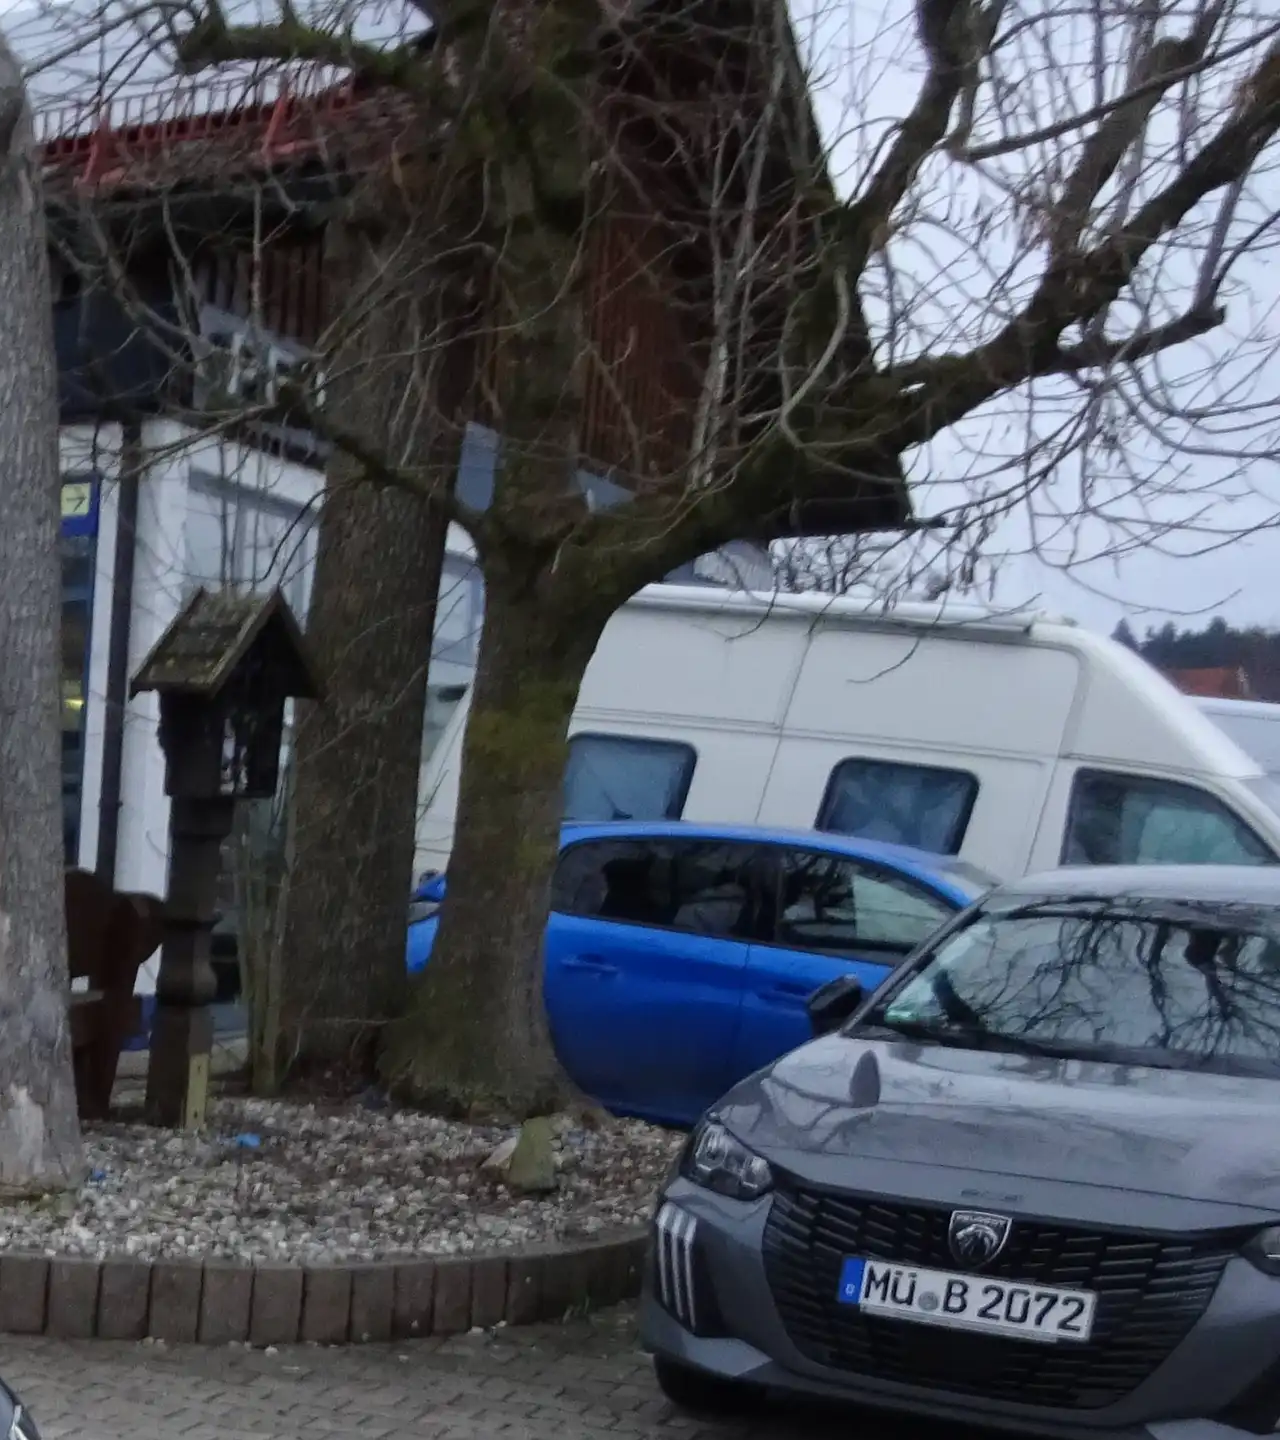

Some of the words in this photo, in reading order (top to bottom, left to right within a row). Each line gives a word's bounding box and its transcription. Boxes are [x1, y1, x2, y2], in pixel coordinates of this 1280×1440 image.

[864, 1265, 918, 1306] MÜ
[943, 1279, 969, 1313] B
[977, 1284, 1086, 1332] 2072
